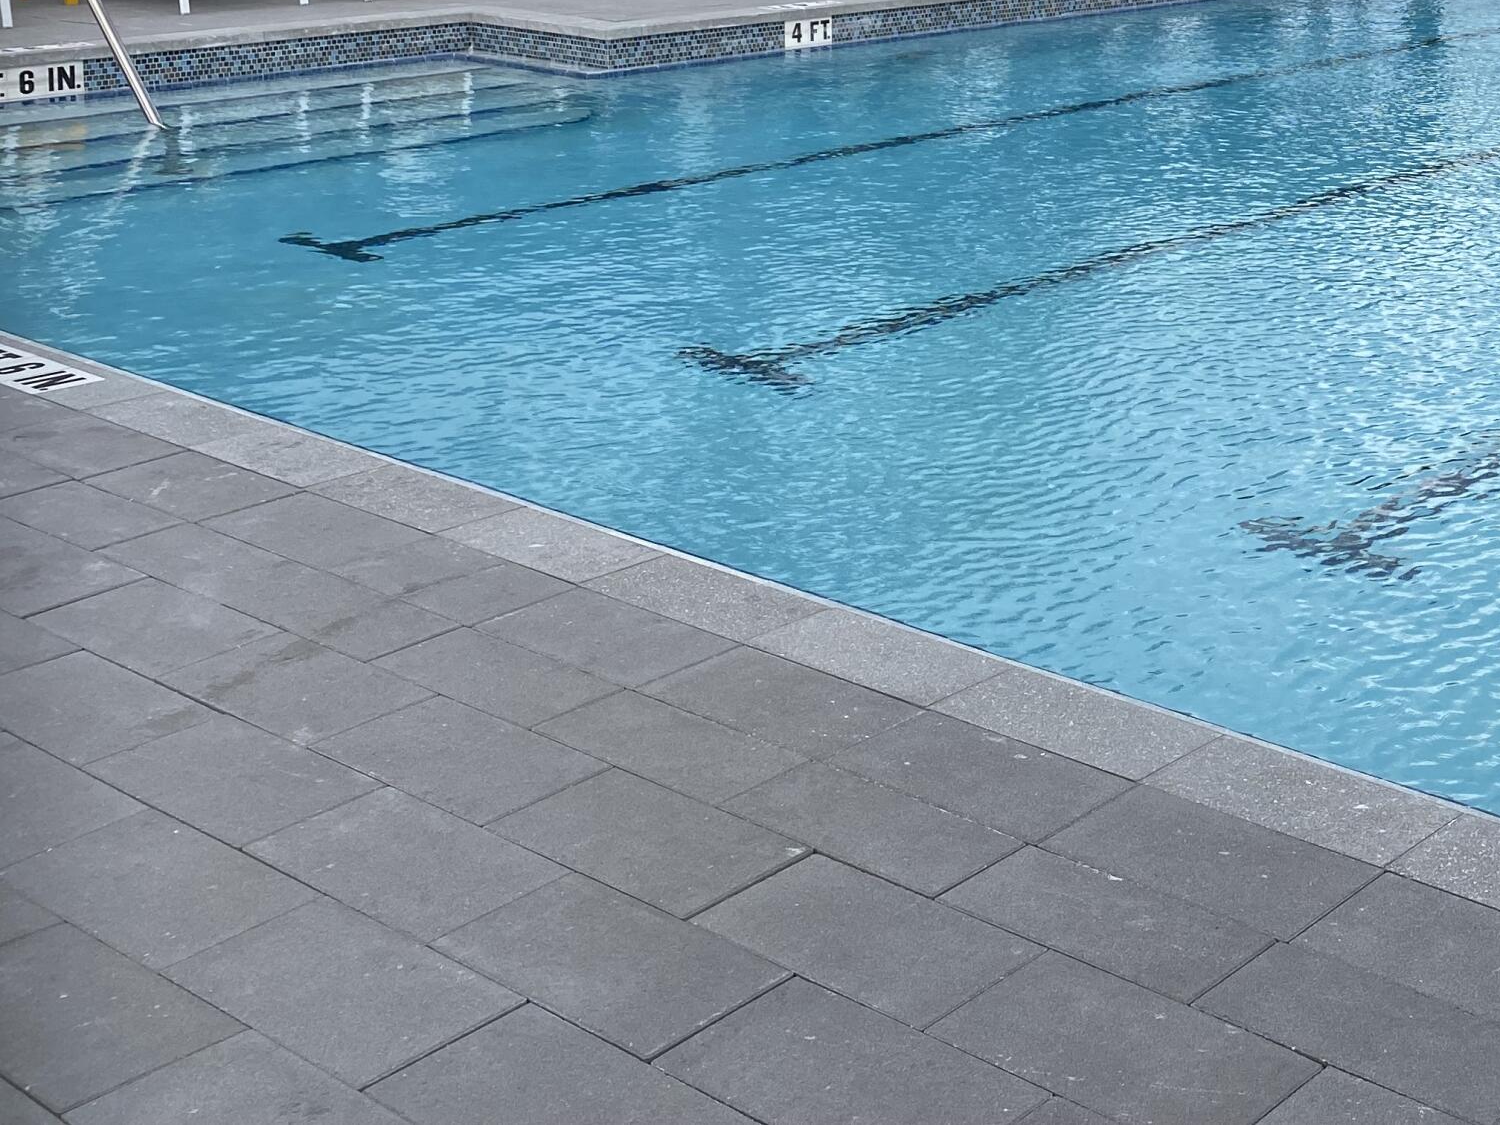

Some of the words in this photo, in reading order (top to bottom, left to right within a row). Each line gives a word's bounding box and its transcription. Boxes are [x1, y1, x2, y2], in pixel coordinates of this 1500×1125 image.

[791, 22, 802, 43] 4
[810, 19, 831, 41] FT.
[19, 70, 34, 94] 6
[48, 65, 81, 91] IN.
[0, 362, 45, 375] 6
[13, 370, 87, 391] IN.
